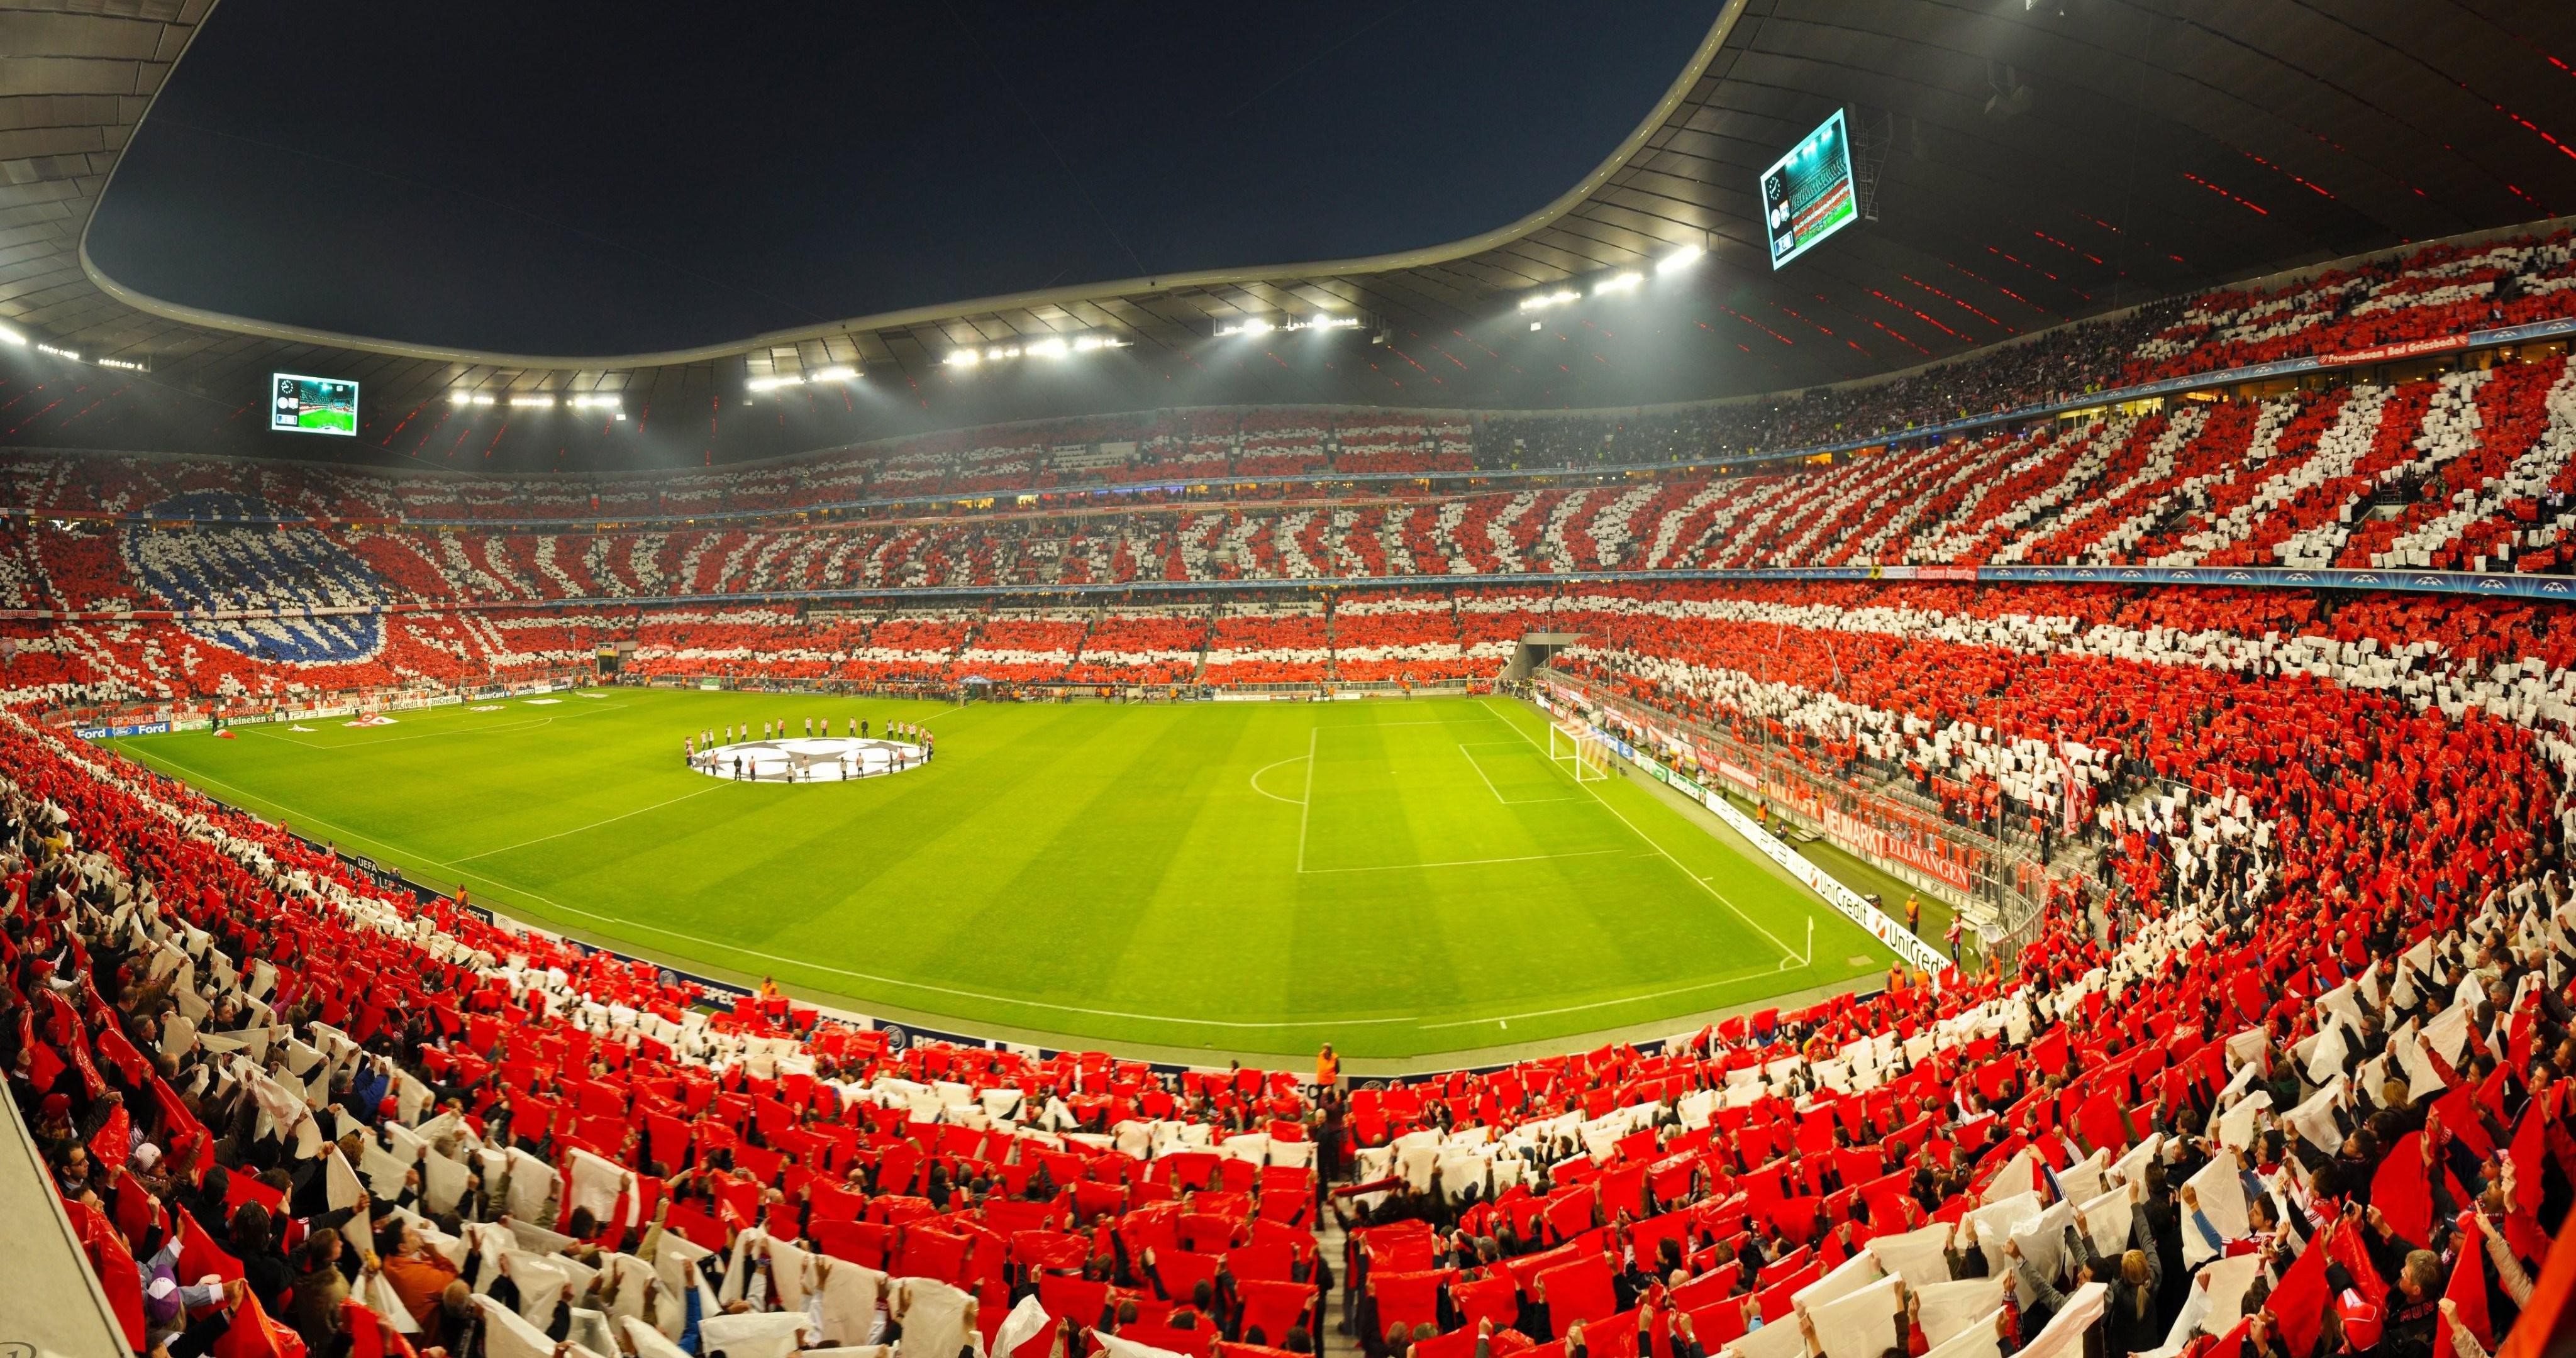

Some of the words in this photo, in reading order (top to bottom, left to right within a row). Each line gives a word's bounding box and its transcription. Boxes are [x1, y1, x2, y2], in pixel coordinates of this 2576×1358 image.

[2387, 345, 2406, 356] Bad
[2408, 336, 2456, 352] Griesbach
[430, 697, 457, 705] UniCredit
[474, 691, 504, 700] MasterCard
[234, 705, 265, 716] SHARKS
[389, 700, 418, 710] UniCredit
[138, 724, 166, 734] Ford
[228, 715, 266, 726] Heineken
[77, 728, 106, 739] Ford
[1668, 768, 1699, 800] Heineken
[1823, 806, 1886, 859] NEUMARKT
[1760, 831, 1787, 864] PS3
[357, 857, 378, 873] UEFA
[1889, 837, 1970, 887] ELLWANGEN
[1819, 874, 1868, 925] UniCredit
[452, 903, 489, 924] RPECT
[1889, 923, 1951, 976] UniCredi
